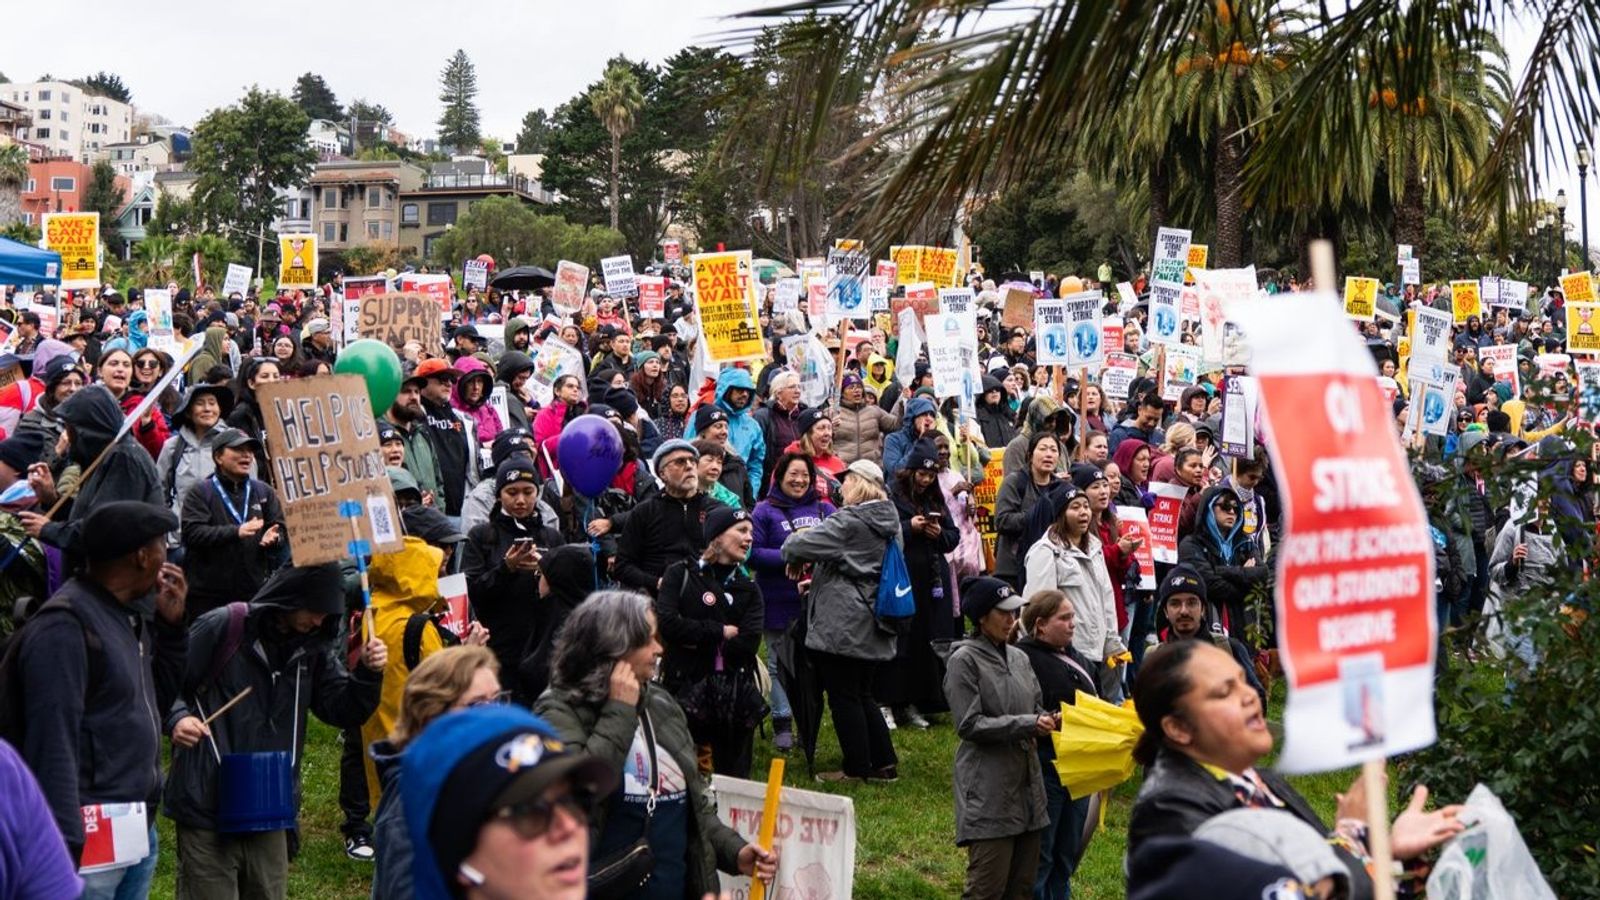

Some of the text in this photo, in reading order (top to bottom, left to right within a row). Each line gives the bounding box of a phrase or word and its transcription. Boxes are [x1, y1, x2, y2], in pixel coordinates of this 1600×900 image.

[59, 219, 83, 227] WE
[1160, 233, 1188, 242] SYMPATHY
[1164, 242, 1182, 251] STRIKE
[709, 262, 737, 275] WE
[700, 288, 746, 303] WAIT
[1153, 286, 1180, 297] SYMPATHY
[943, 295, 971, 304] SYMPATHY
[1157, 296, 1174, 305] STRIKE
[949, 304, 967, 312] STRIKE
[1039, 306, 1063, 316] SYMPA
[1067, 299, 1099, 313] SYMPATHY
[1045, 315, 1064, 324] STRIK
[1073, 311, 1093, 322] STRIKE
[1418, 313, 1448, 326] SYMPATHY
[1423, 325, 1442, 337] STRIKE
[1425, 335, 1437, 345] FOR
[1325, 383, 1365, 435] ON
[274, 392, 374, 452] HELP US
[277, 449, 389, 503] HELP STUDENTS
[1312, 456, 1401, 513] STRIKE
[1159, 501, 1170, 510] ON
[1153, 513, 1173, 524] STRIKE
[1129, 525, 1140, 534] ON
[1293, 565, 1420, 612] OUR STUDENTS
[1318, 610, 1395, 651] DESERVE
[83, 805, 99, 833] DES
